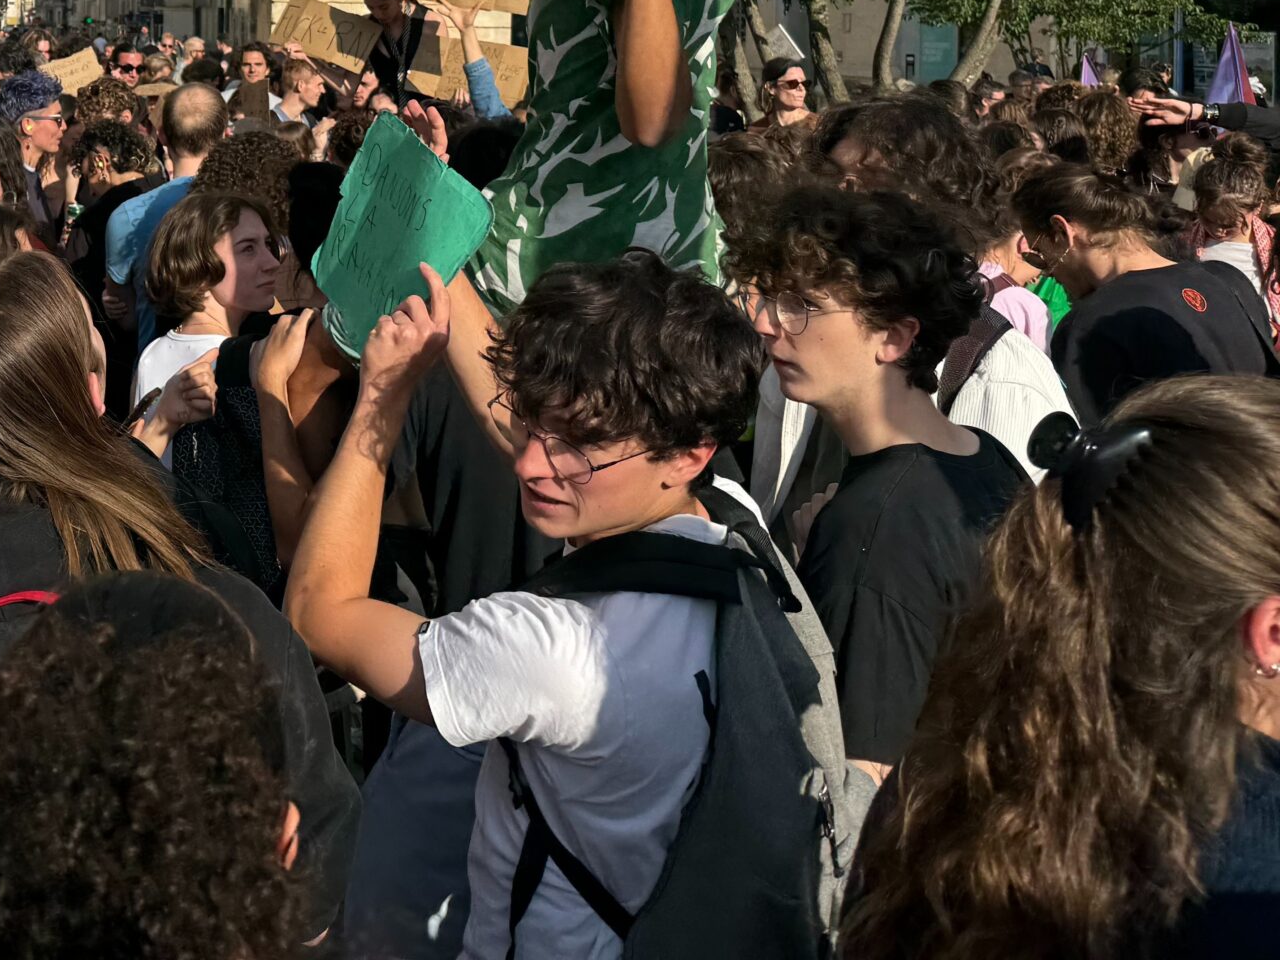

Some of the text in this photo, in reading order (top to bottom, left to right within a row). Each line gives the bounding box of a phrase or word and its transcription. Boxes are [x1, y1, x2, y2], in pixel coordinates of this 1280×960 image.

[274, 4, 322, 44] FUCK
[326, 20, 376, 67] RN
[344, 193, 376, 232] LA
[361, 143, 433, 231] DANSONS
